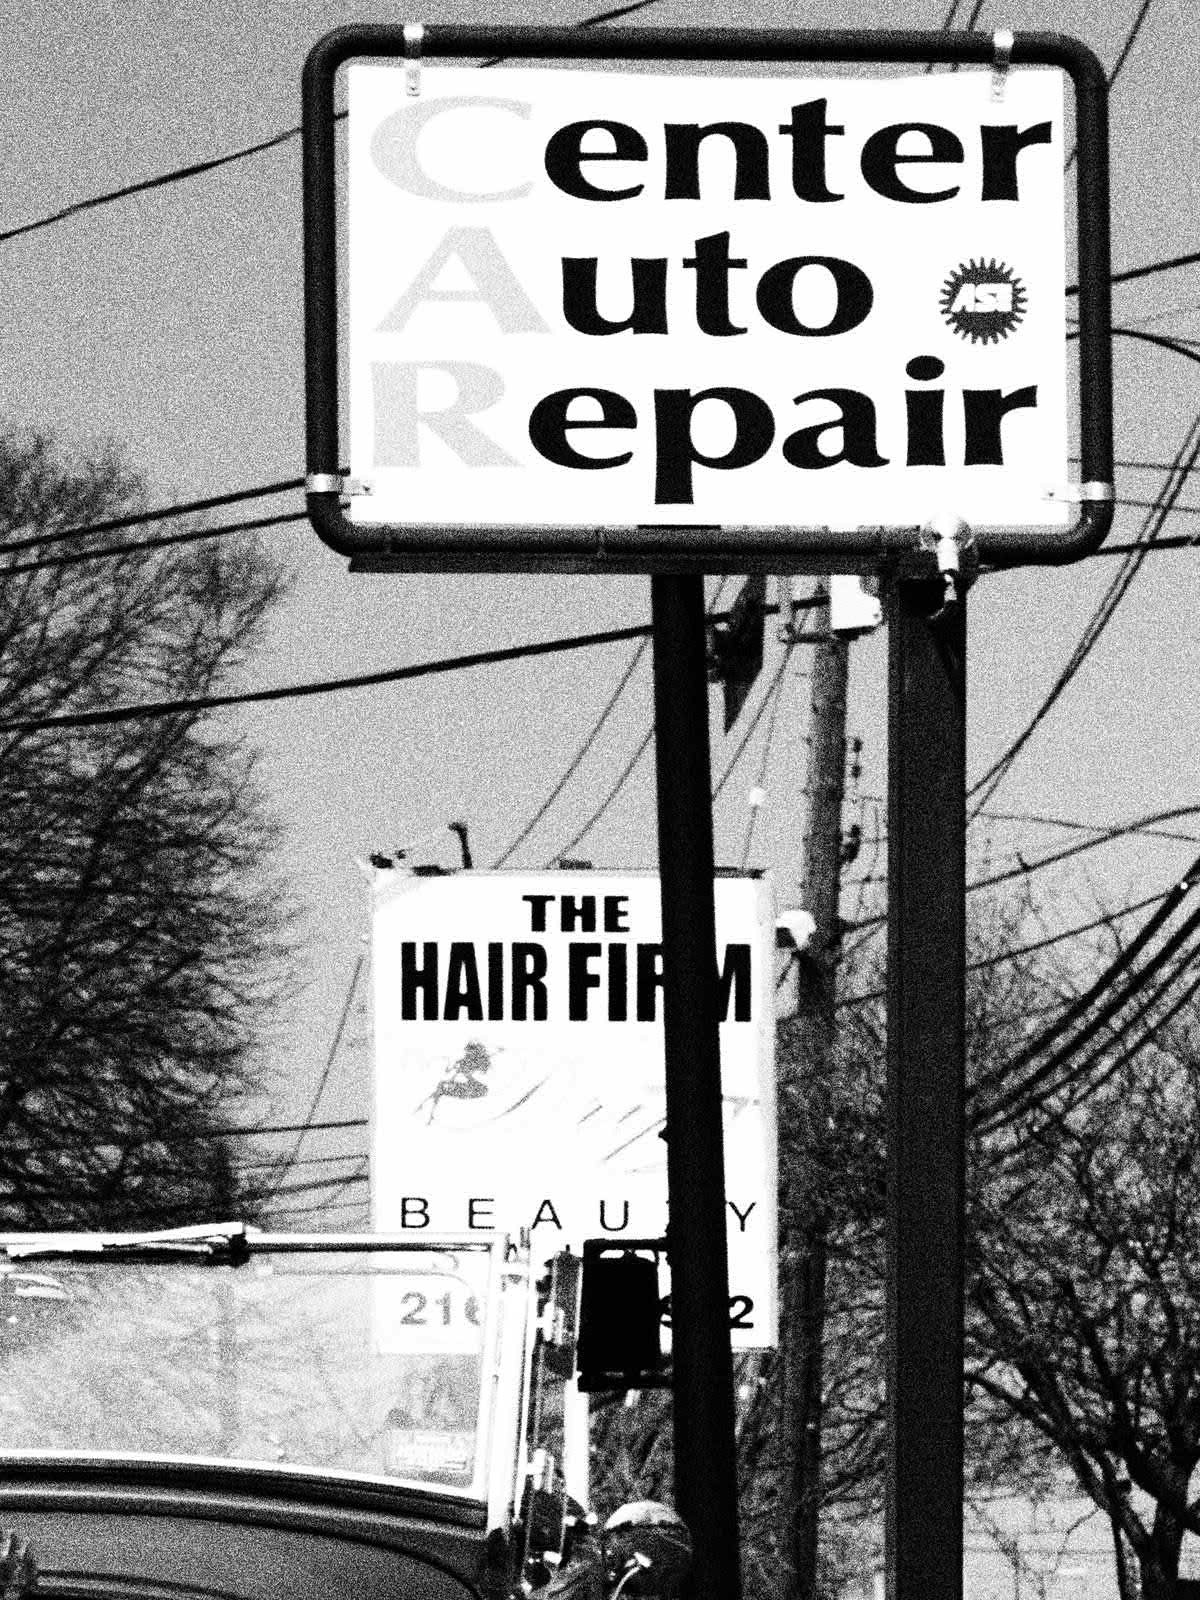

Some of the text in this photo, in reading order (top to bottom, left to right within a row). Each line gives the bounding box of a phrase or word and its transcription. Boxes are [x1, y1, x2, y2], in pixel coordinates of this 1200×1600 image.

[371, 96, 1052, 204] Center
[376, 228, 875, 337] Auto
[371, 355, 1038, 505] Repair
[522, 895, 630, 932] THE
[401, 941, 548, 1021] HAIR
[400, 1197, 756, 1232] BEAUY
